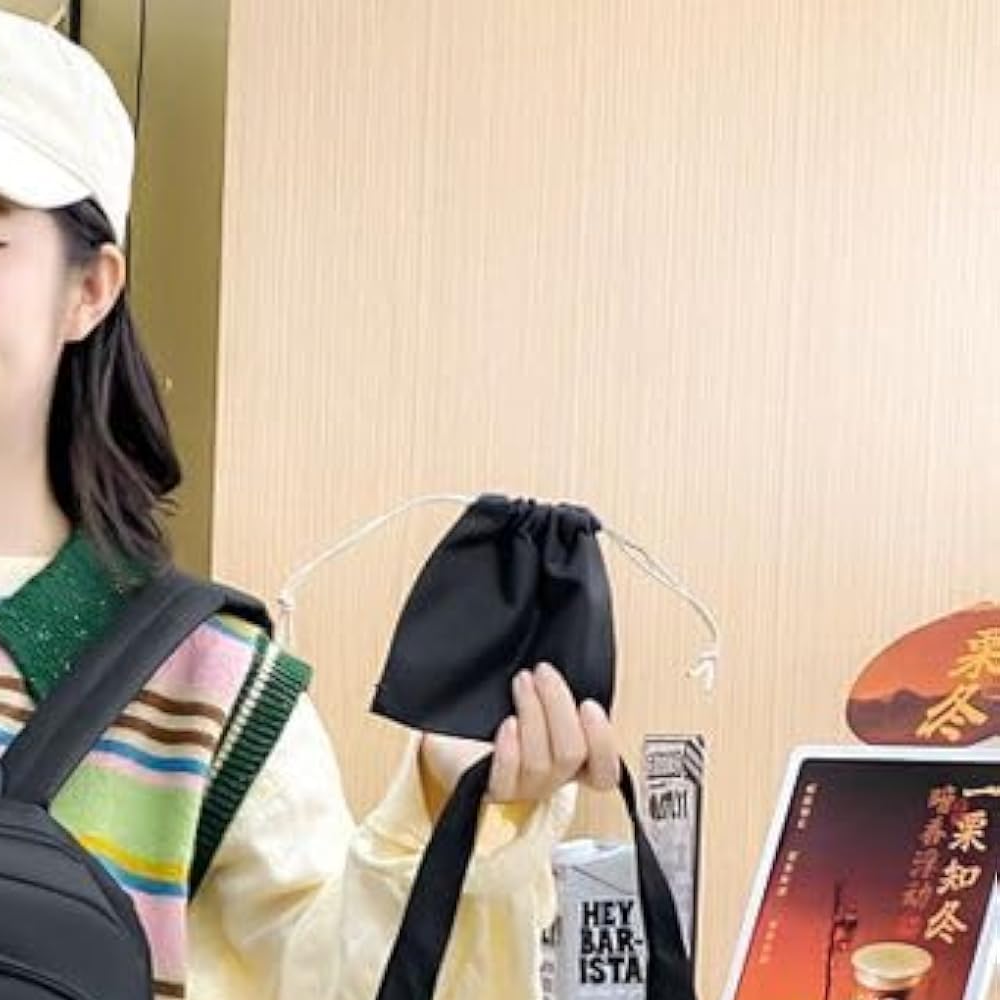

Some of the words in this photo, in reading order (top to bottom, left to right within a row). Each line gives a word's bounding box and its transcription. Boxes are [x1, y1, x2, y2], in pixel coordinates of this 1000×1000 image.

[583, 900, 634, 926] HEY
[581, 928, 643, 954] BAR-
[580, 956, 644, 984] ISTA
